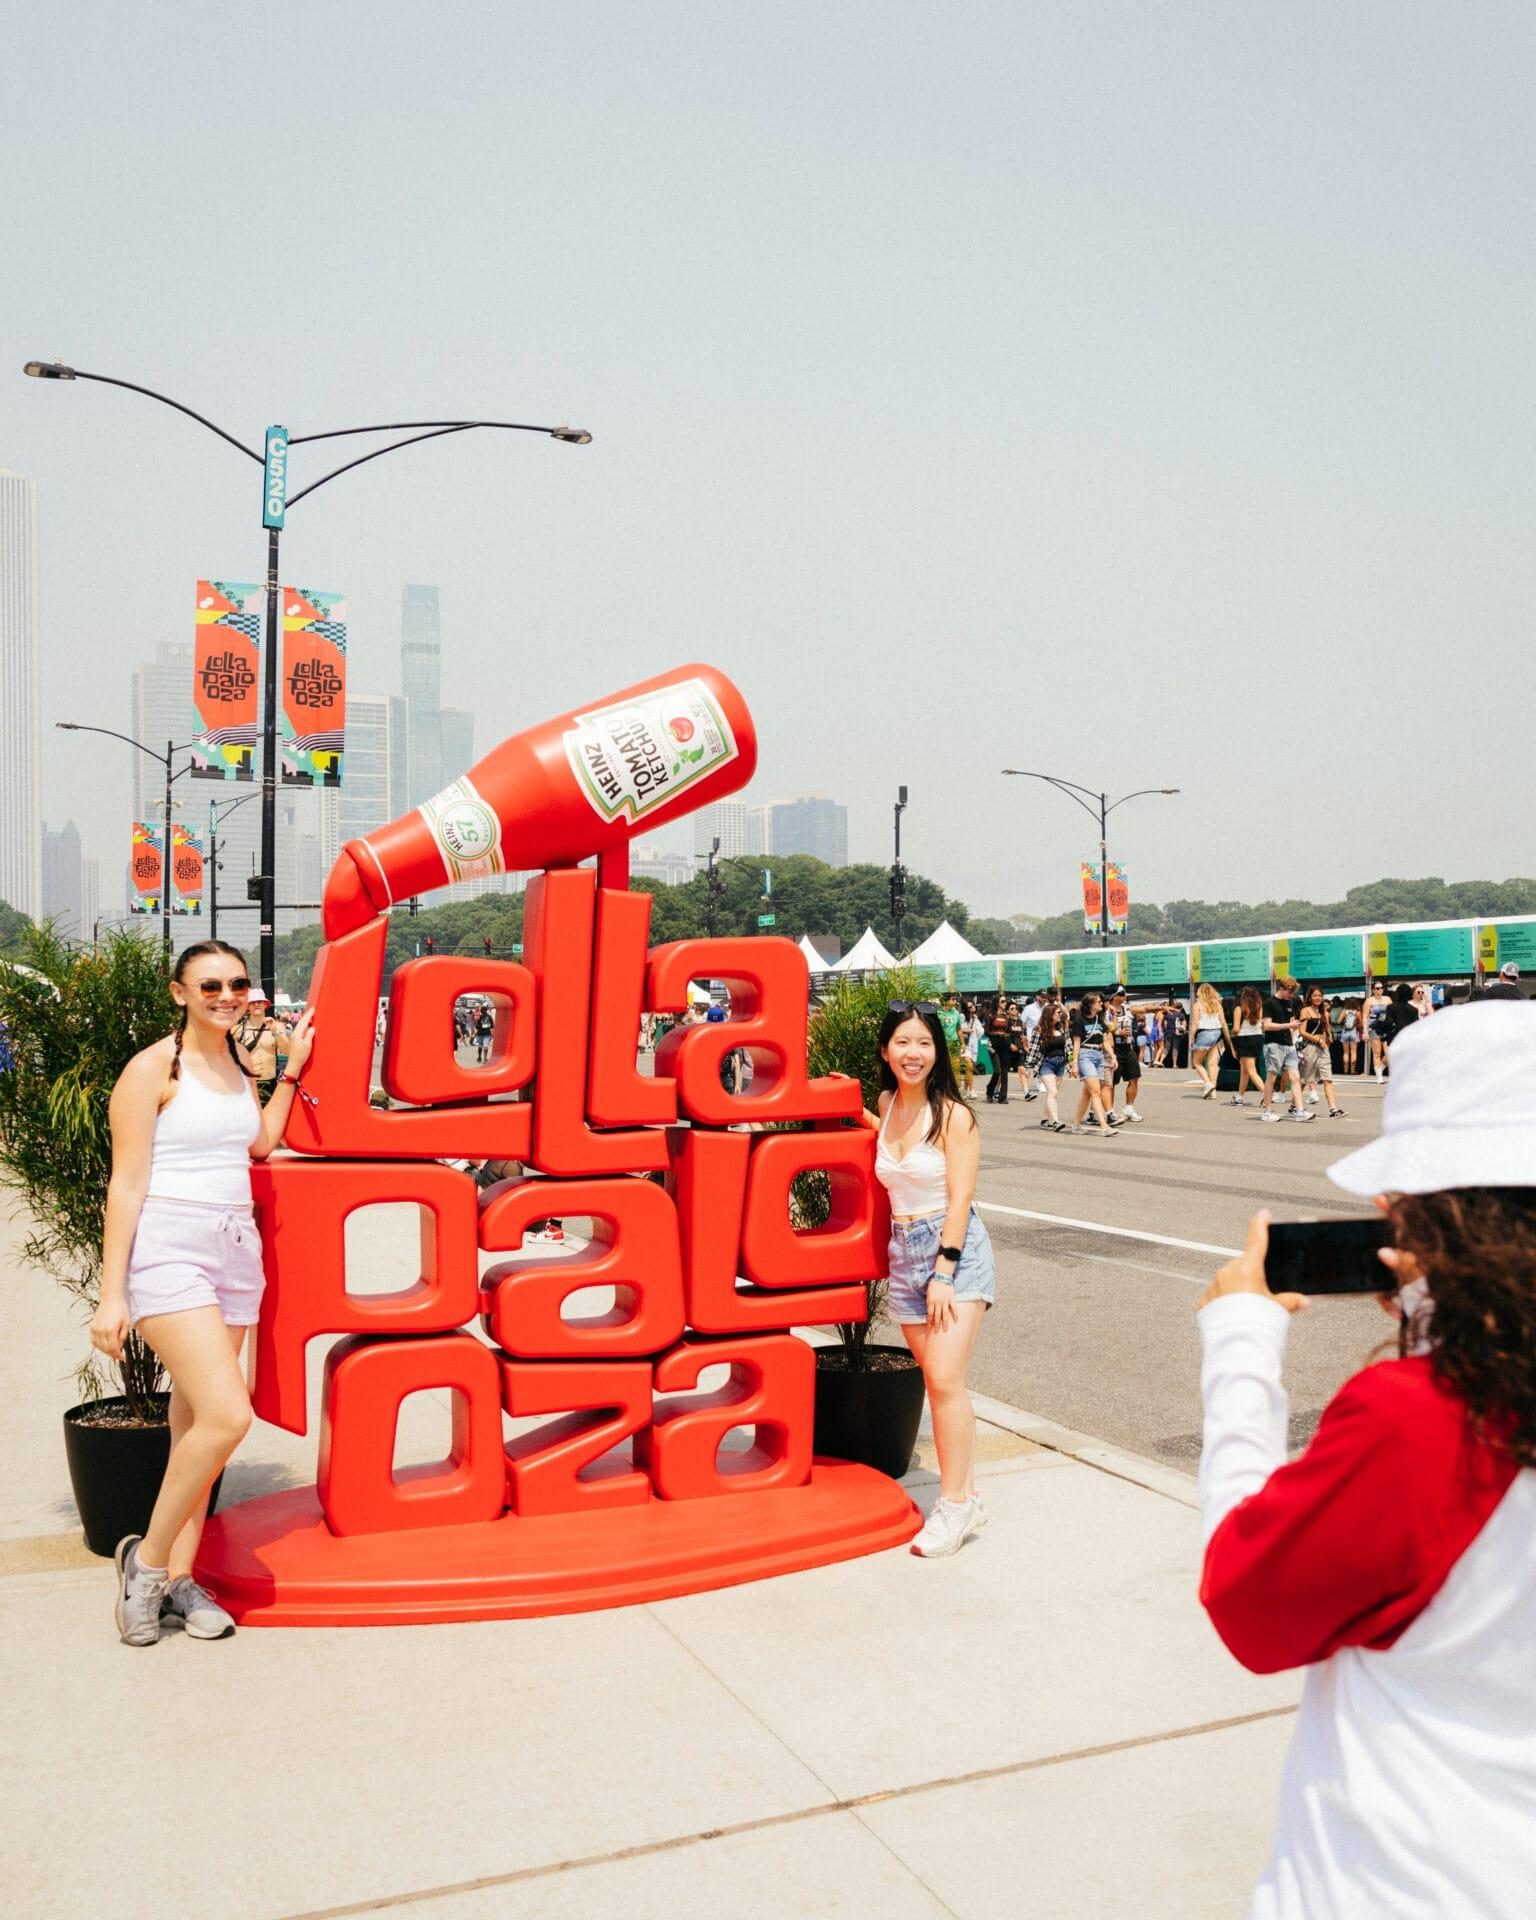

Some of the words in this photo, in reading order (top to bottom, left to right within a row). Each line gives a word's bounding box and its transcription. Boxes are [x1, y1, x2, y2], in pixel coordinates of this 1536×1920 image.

[267, 437, 287, 517] C520
[585, 743, 622, 800] HEINZ
[606, 719, 655, 800] TOMATO
[625, 714, 669, 787] KETCHUP
[445, 821, 464, 852] HEINZ
[456, 821, 479, 843] 57
